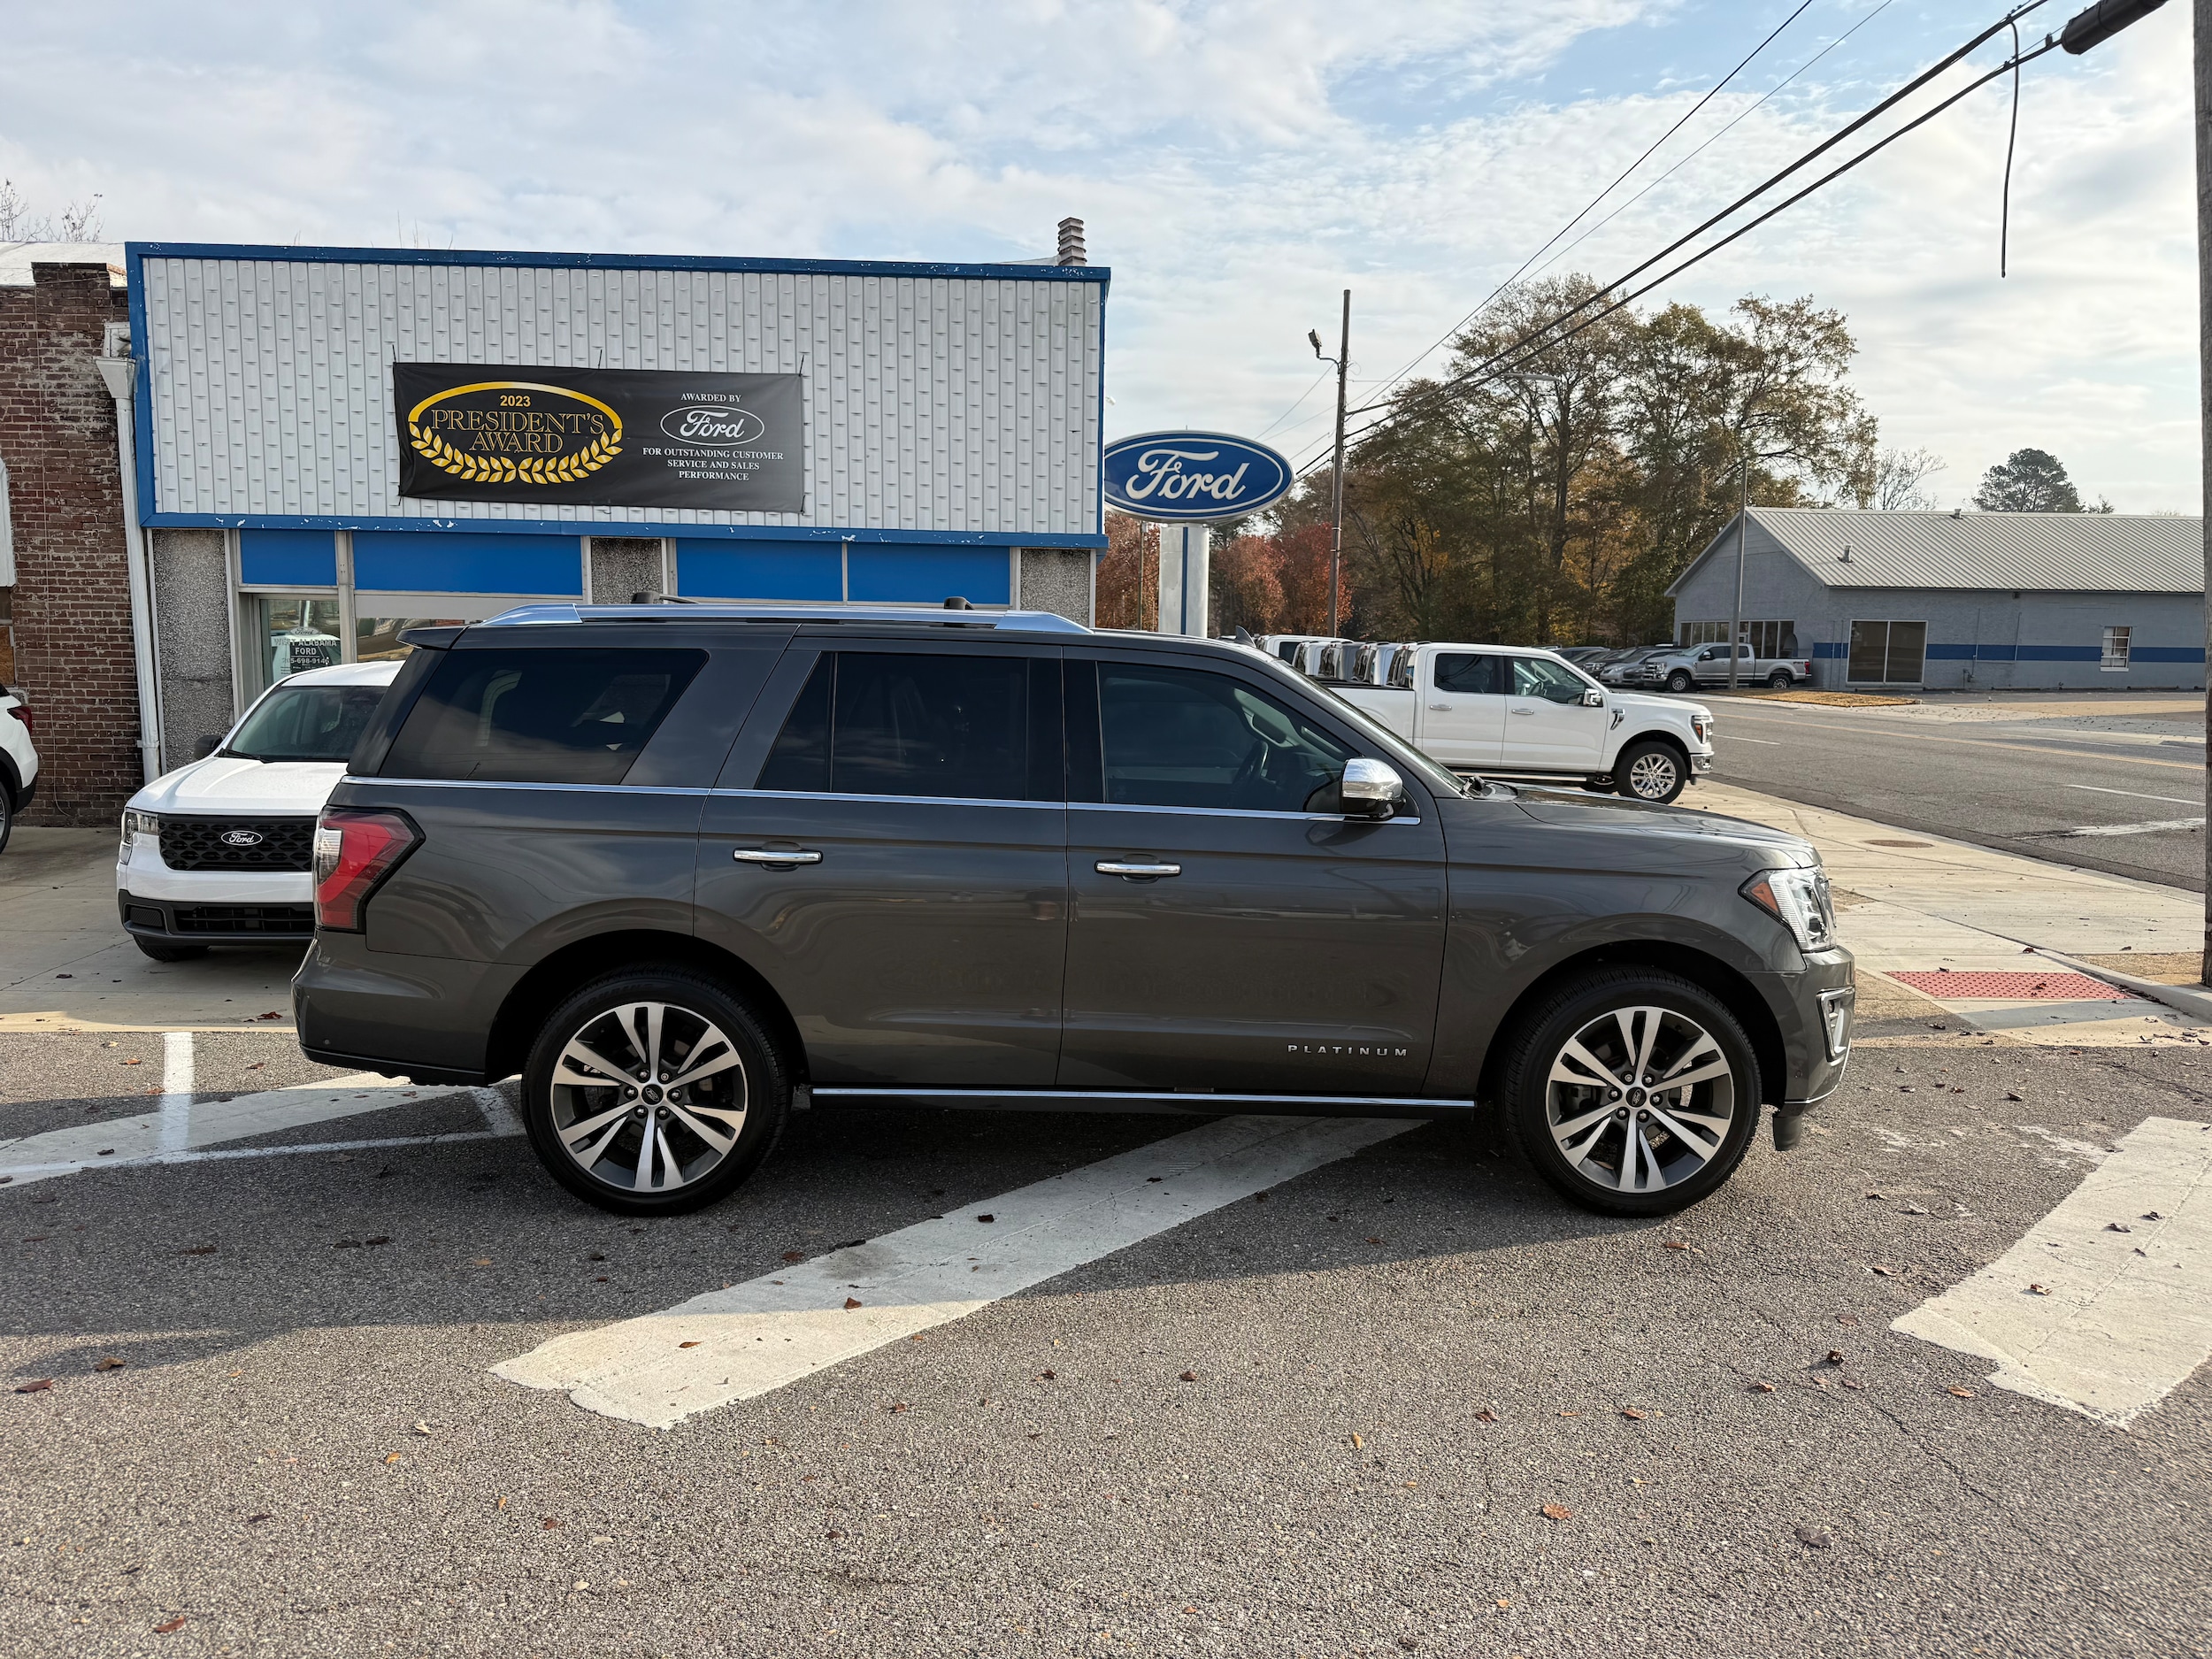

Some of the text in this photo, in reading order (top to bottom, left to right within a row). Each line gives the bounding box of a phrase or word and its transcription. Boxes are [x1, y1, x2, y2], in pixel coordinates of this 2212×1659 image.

[500, 395, 531, 407] 2023
[680, 393, 741, 403] AWARDED BY
[431, 409, 604, 434] PRESIDENT'S
[680, 410, 745, 438] Ford
[469, 431, 564, 454] AWARD
[642, 447, 784, 460] FOR OUTSTANDING CUSTOMER
[667, 459, 760, 470] SERVICE AND SALES
[679, 470, 749, 480] PERFORMANCE
[1125, 449, 1250, 501] Ford
[295, 647, 317, 656] FORD
[228, 832, 255, 843] Ford
[1287, 1044, 1408, 1056] PLATINUM
